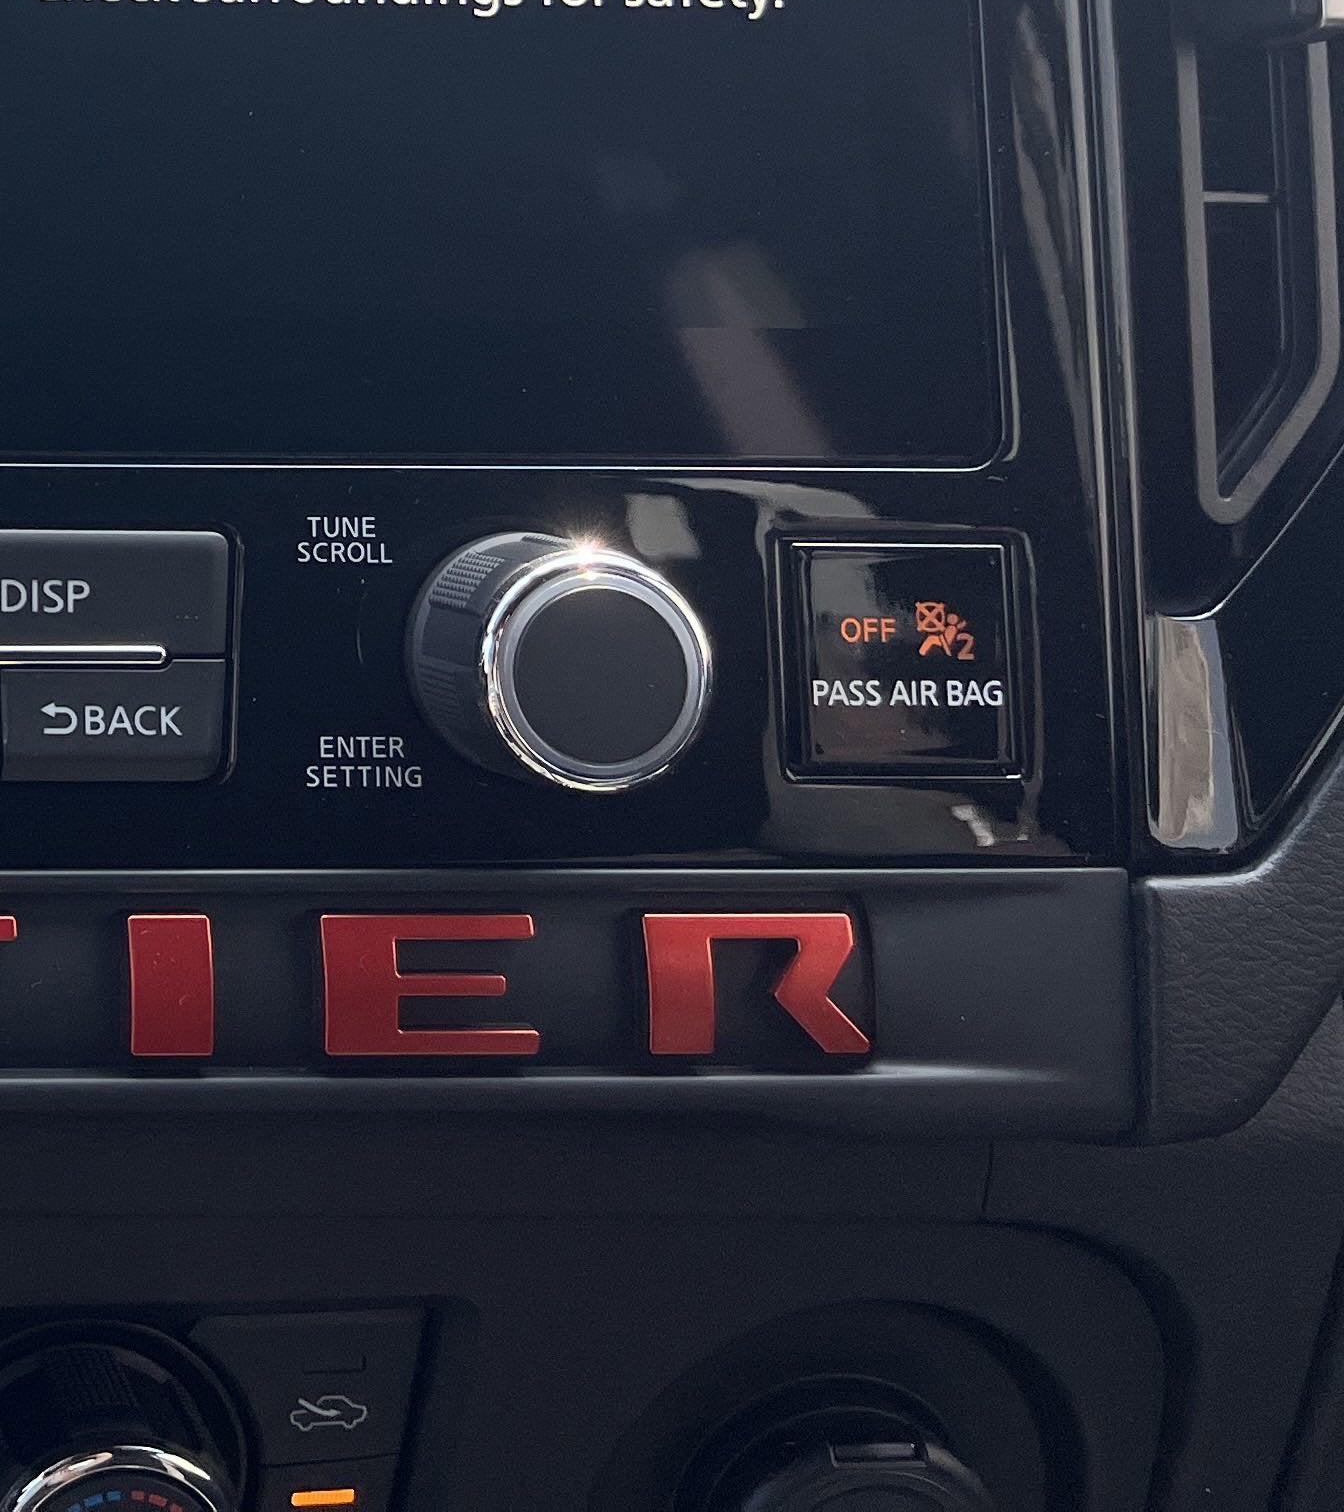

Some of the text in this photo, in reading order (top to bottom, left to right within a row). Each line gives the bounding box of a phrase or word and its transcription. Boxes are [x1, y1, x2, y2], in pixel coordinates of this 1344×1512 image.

[306, 516, 376, 538] TUNE
[297, 541, 393, 564] SCROLL
[0, 579, 91, 614] DISP
[840, 616, 896, 644] OFF
[812, 679, 1003, 707] PASS AIR BAG
[84, 705, 183, 737] BACK
[319, 736, 405, 759] ENTER
[306, 765, 423, 789] SETTING
